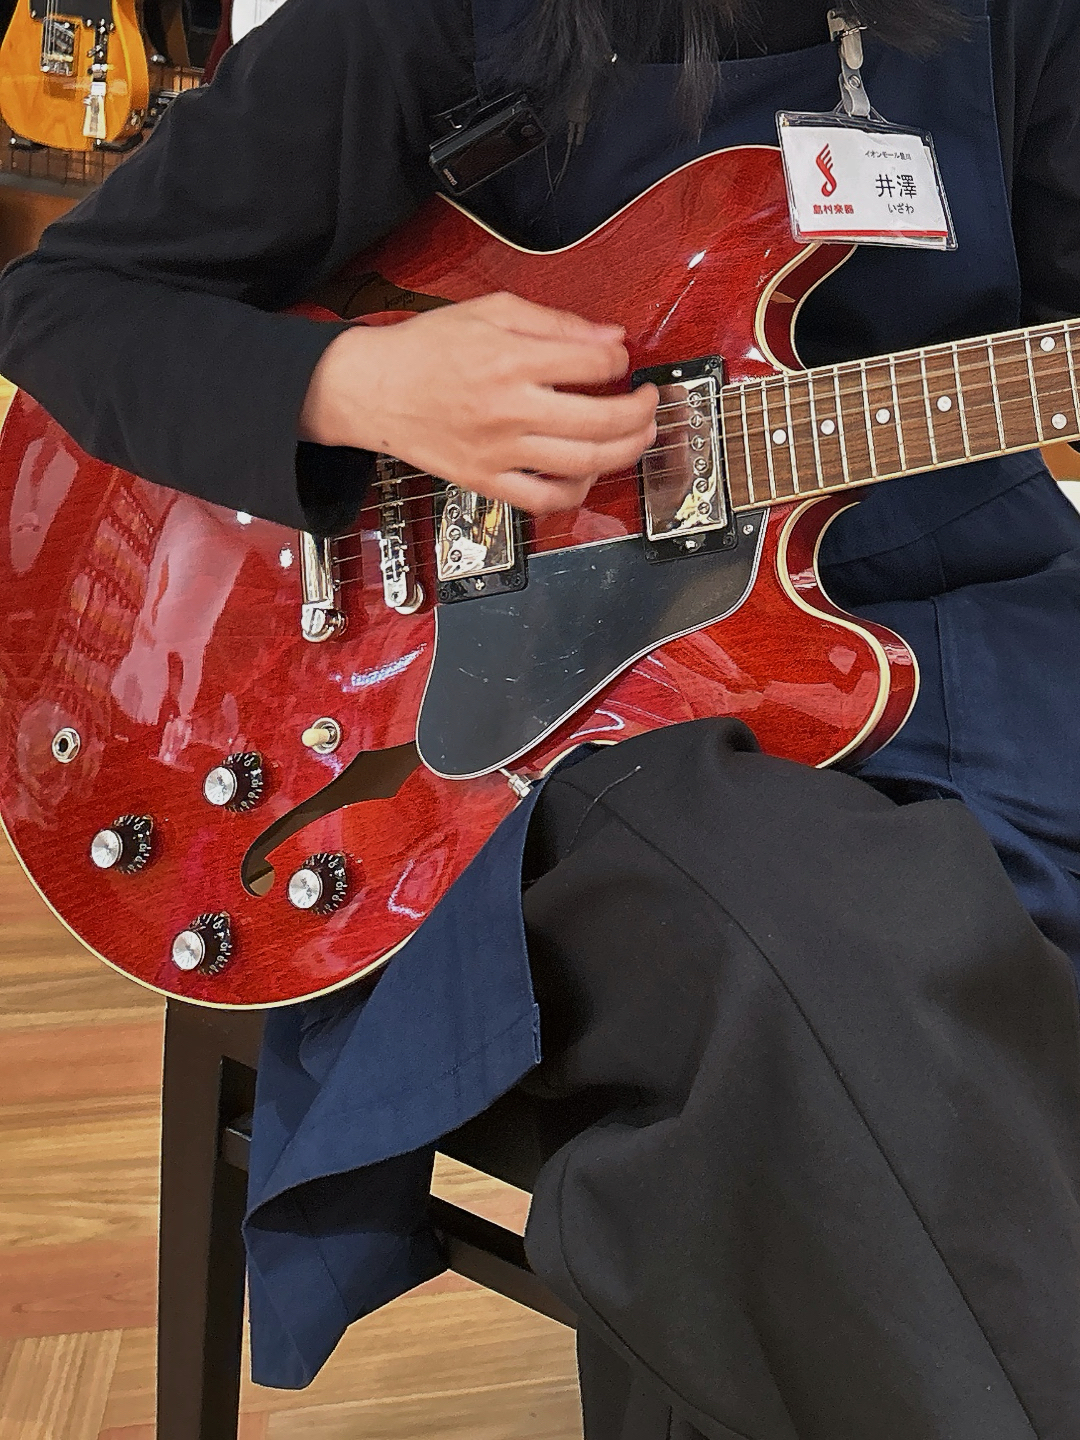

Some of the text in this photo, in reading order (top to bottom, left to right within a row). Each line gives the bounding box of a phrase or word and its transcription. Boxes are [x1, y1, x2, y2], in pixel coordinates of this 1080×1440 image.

[875, 173, 917, 199] 井澤
[813, 204, 855, 215] 島村楽器
[887, 203, 915, 214] いざわ
